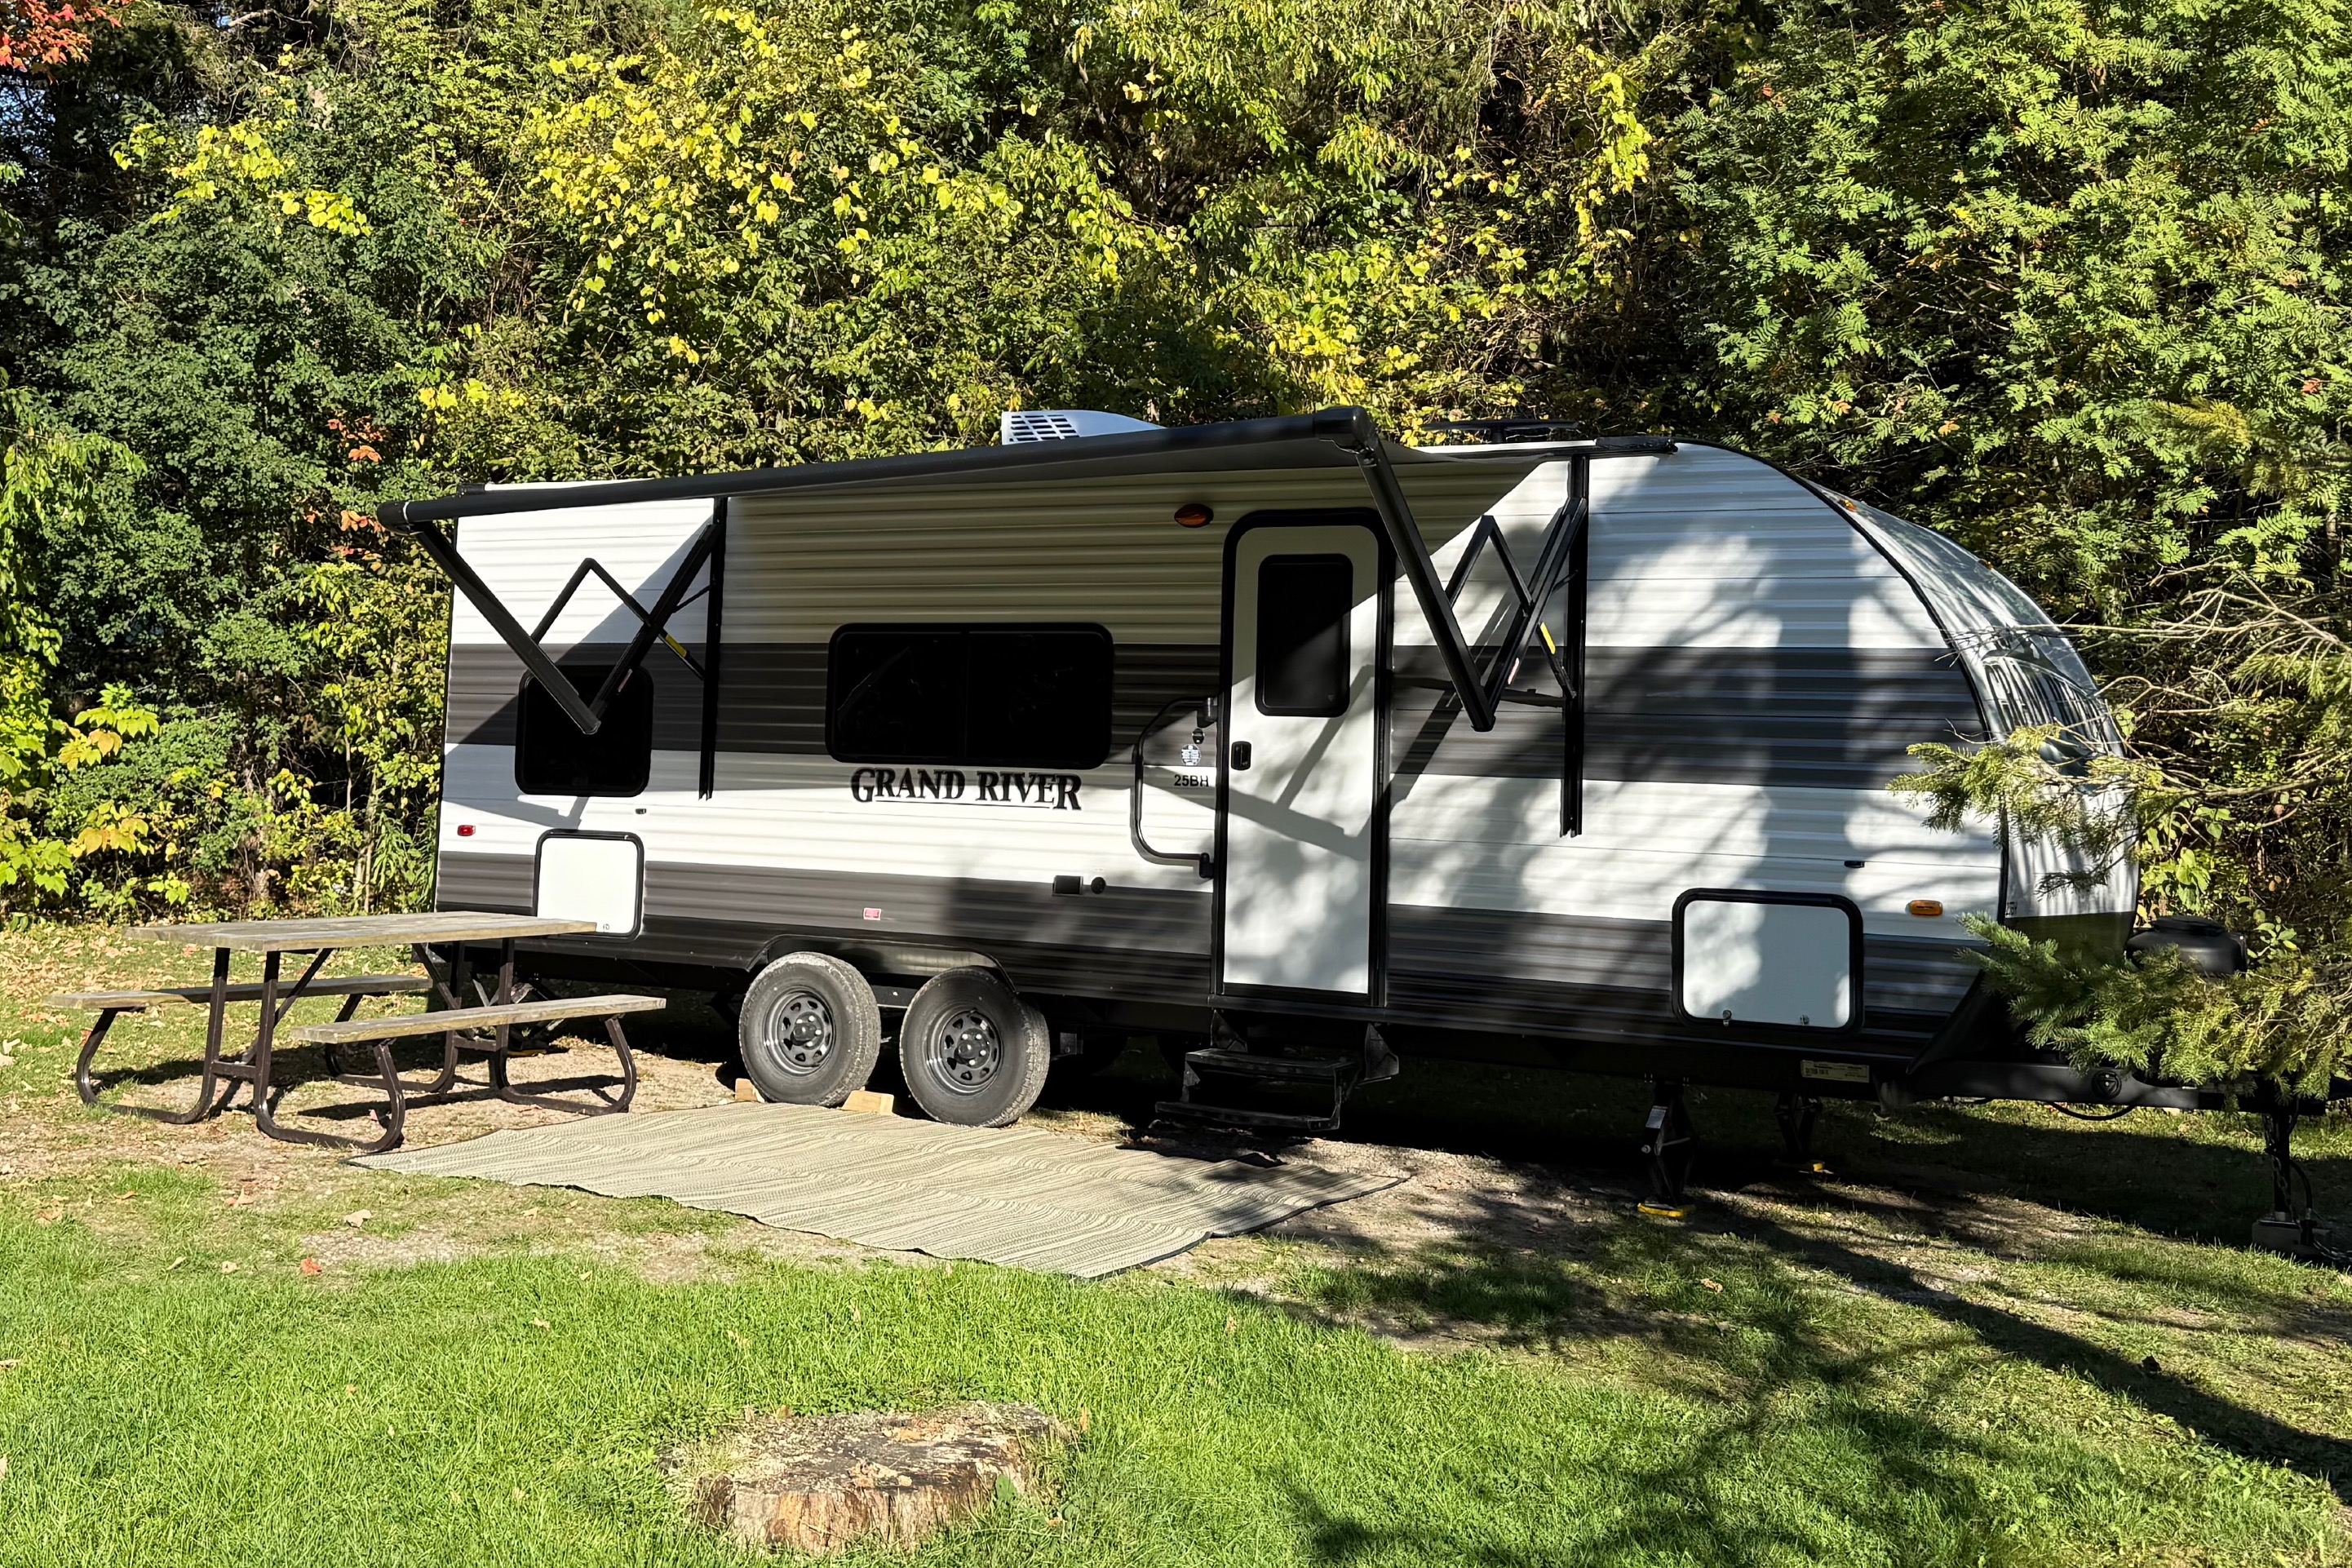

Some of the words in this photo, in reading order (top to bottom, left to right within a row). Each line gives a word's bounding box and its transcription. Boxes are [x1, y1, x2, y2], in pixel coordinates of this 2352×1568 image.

[850, 767, 966, 803] GRAND
[975, 770, 1083, 811] RIVER
[1174, 773, 1209, 787] 25BH
